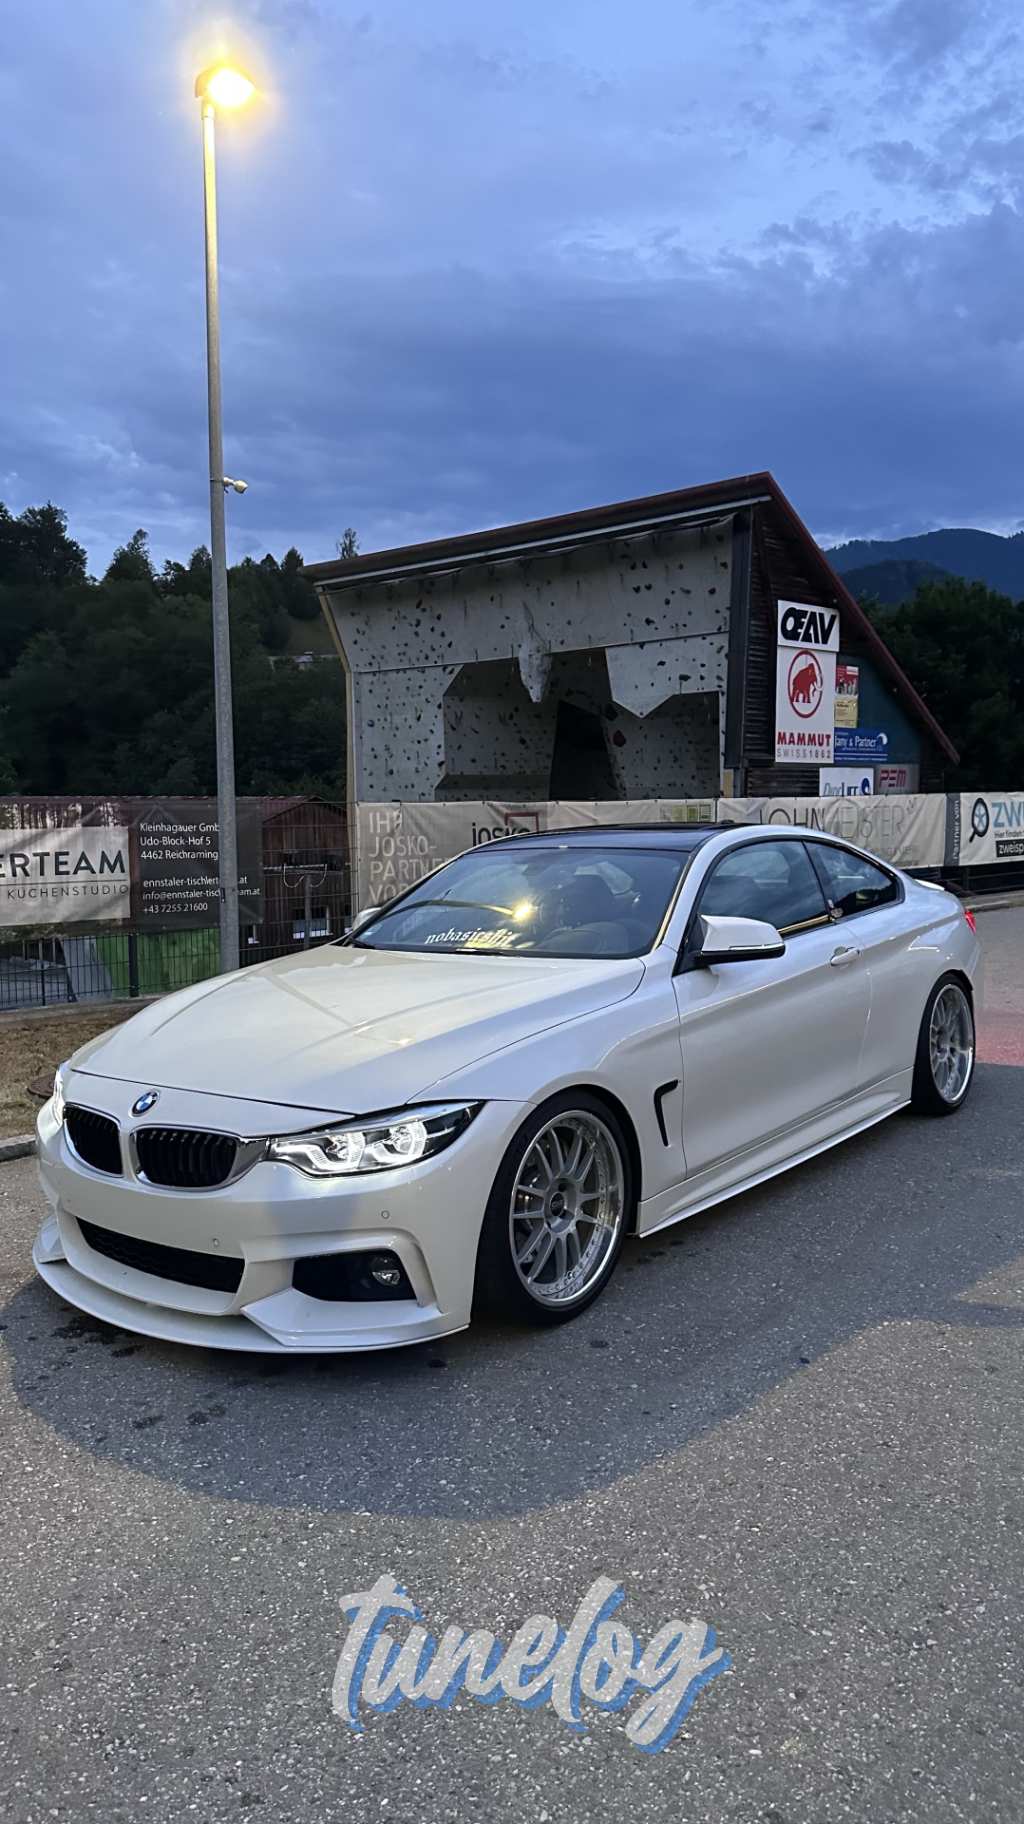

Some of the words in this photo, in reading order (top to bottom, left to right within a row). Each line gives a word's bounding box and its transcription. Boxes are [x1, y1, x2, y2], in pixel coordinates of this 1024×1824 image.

[777, 731, 831, 747] MAMMUT
[992, 801, 1024, 828] ZW
[140, 822, 197, 834] Kleinhagauer
[199, 823, 220, 833] Gmb
[140, 836, 204, 847] Udo-Block-Hof
[205, 836, 211, 846] 5
[368, 835, 437, 857] JOSKO-
[140, 851, 163, 860] 4462
[165, 849, 219, 861] Reichraming
[144, 904, 159, 914] +43
[161, 904, 182, 914] 7255
[184, 902, 208, 913] 21600
